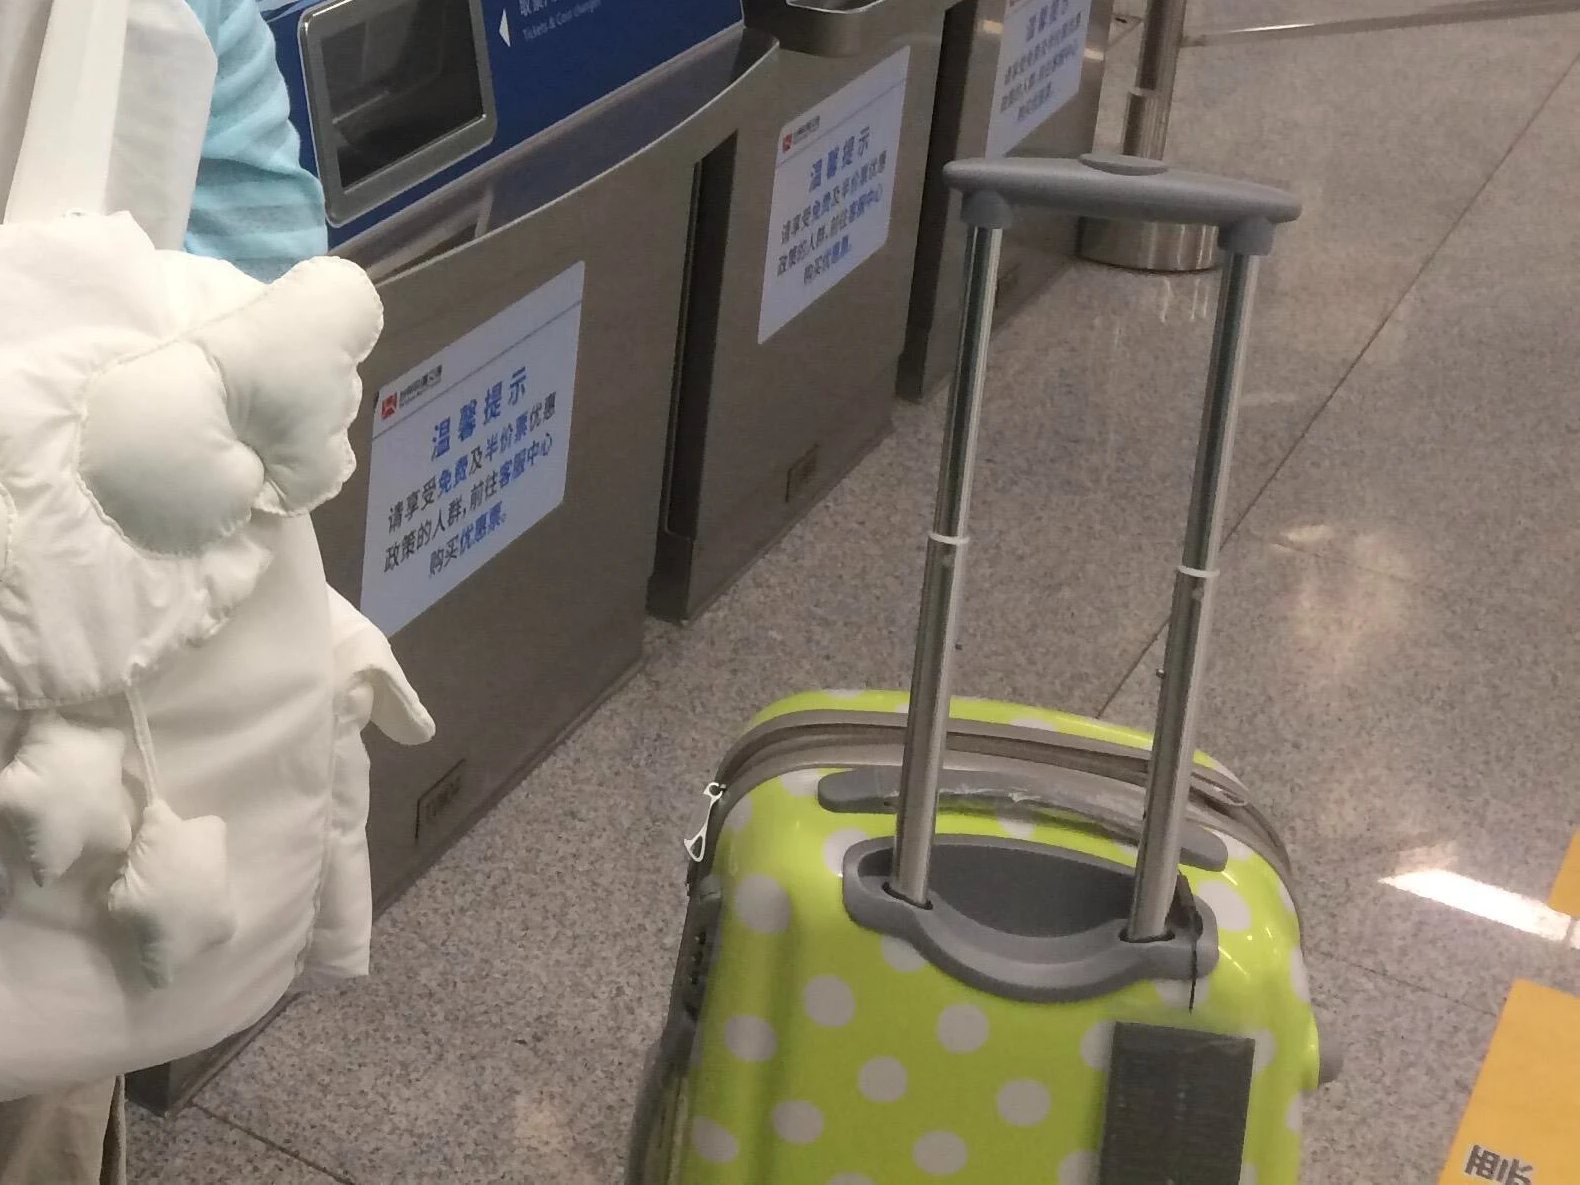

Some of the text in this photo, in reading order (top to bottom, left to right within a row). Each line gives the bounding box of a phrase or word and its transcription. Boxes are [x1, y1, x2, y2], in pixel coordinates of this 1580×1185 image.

[388, 390, 557, 533] 请享受免费及半价票优惠
[430, 366, 527, 462] 温馨提示
